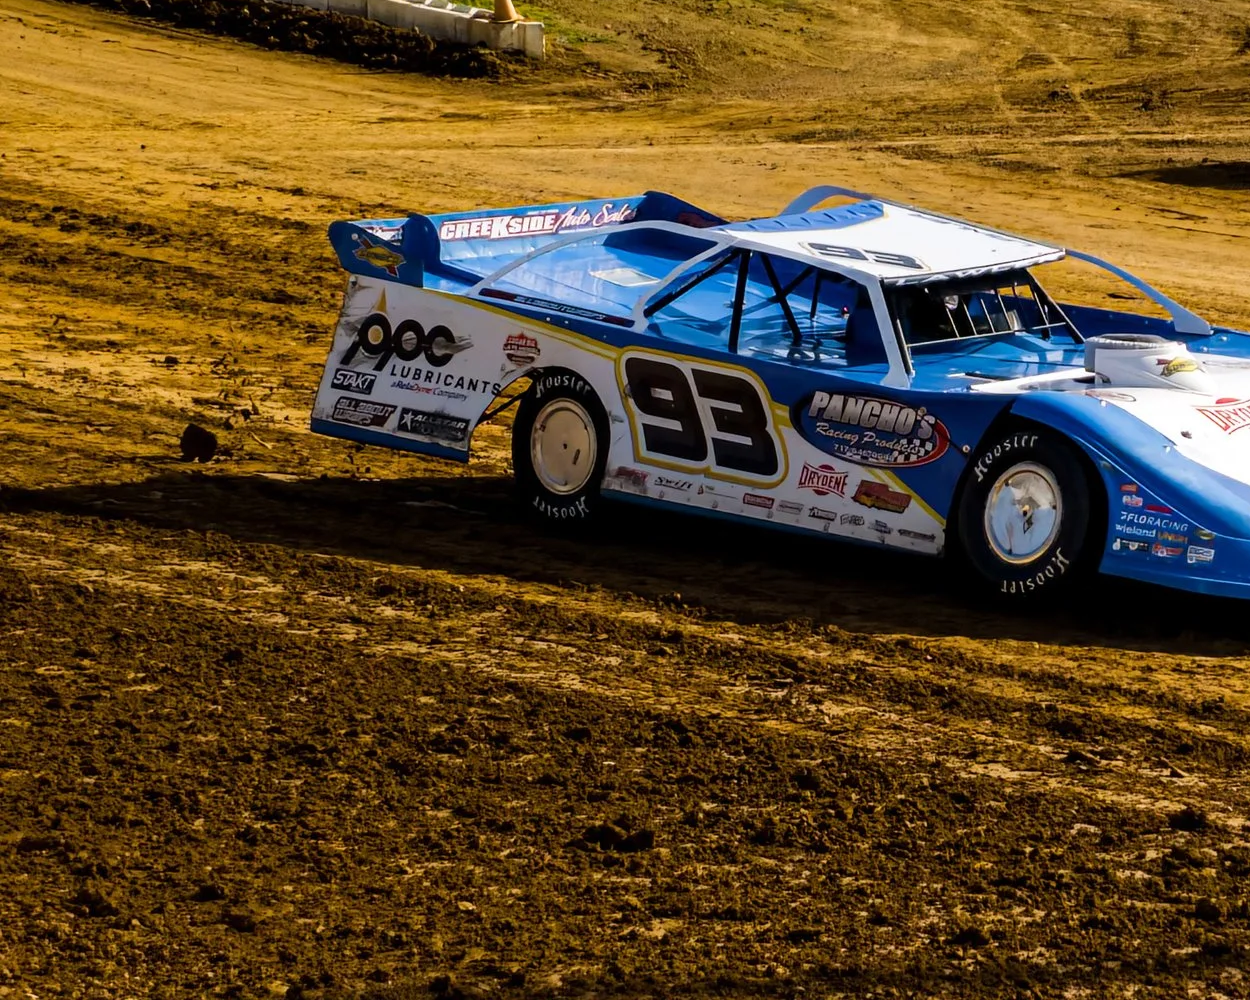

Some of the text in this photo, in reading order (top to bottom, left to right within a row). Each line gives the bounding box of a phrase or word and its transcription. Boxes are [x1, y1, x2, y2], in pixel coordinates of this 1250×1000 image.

[390, 364, 502, 396] LUBRICANTS
[433, 387, 469, 402] Company
[625, 357, 779, 476] 93
[808, 390, 936, 440] PANCHO'S
[815, 422, 859, 445] Racing
[862, 431, 921, 454] Products
[655, 476, 693, 490] Swift
[799, 464, 849, 495] DRYDENE
[1115, 523, 1157, 538] wieland
[1126, 512, 1189, 532] FLORACING
